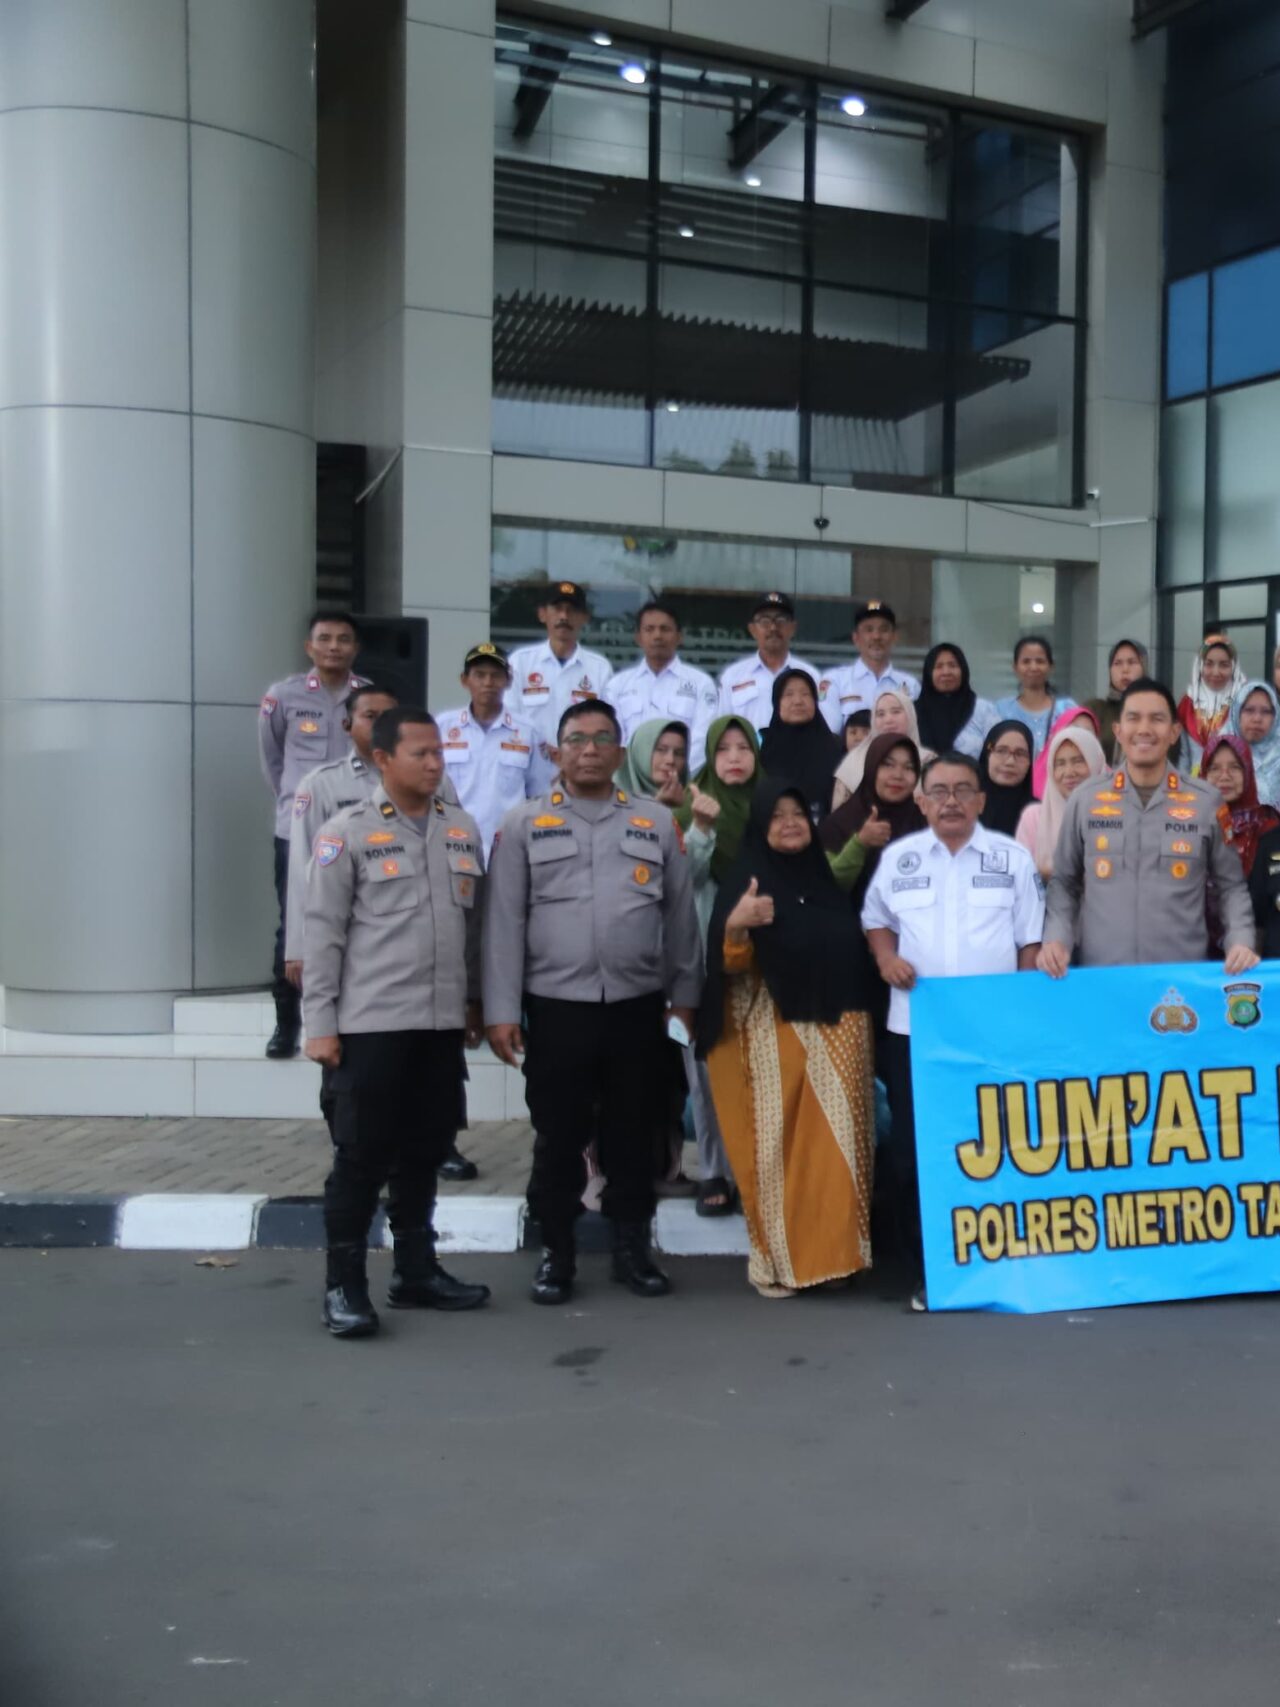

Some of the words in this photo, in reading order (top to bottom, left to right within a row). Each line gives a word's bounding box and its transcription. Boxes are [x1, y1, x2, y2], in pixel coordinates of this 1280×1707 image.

[626, 829, 660, 842] POLRI
[1164, 822, 1199, 833] POLRI
[955, 1066, 1256, 1182] JUM'AT
[952, 1194, 1098, 1266] POLRES
[1104, 1184, 1234, 1250] METRO
